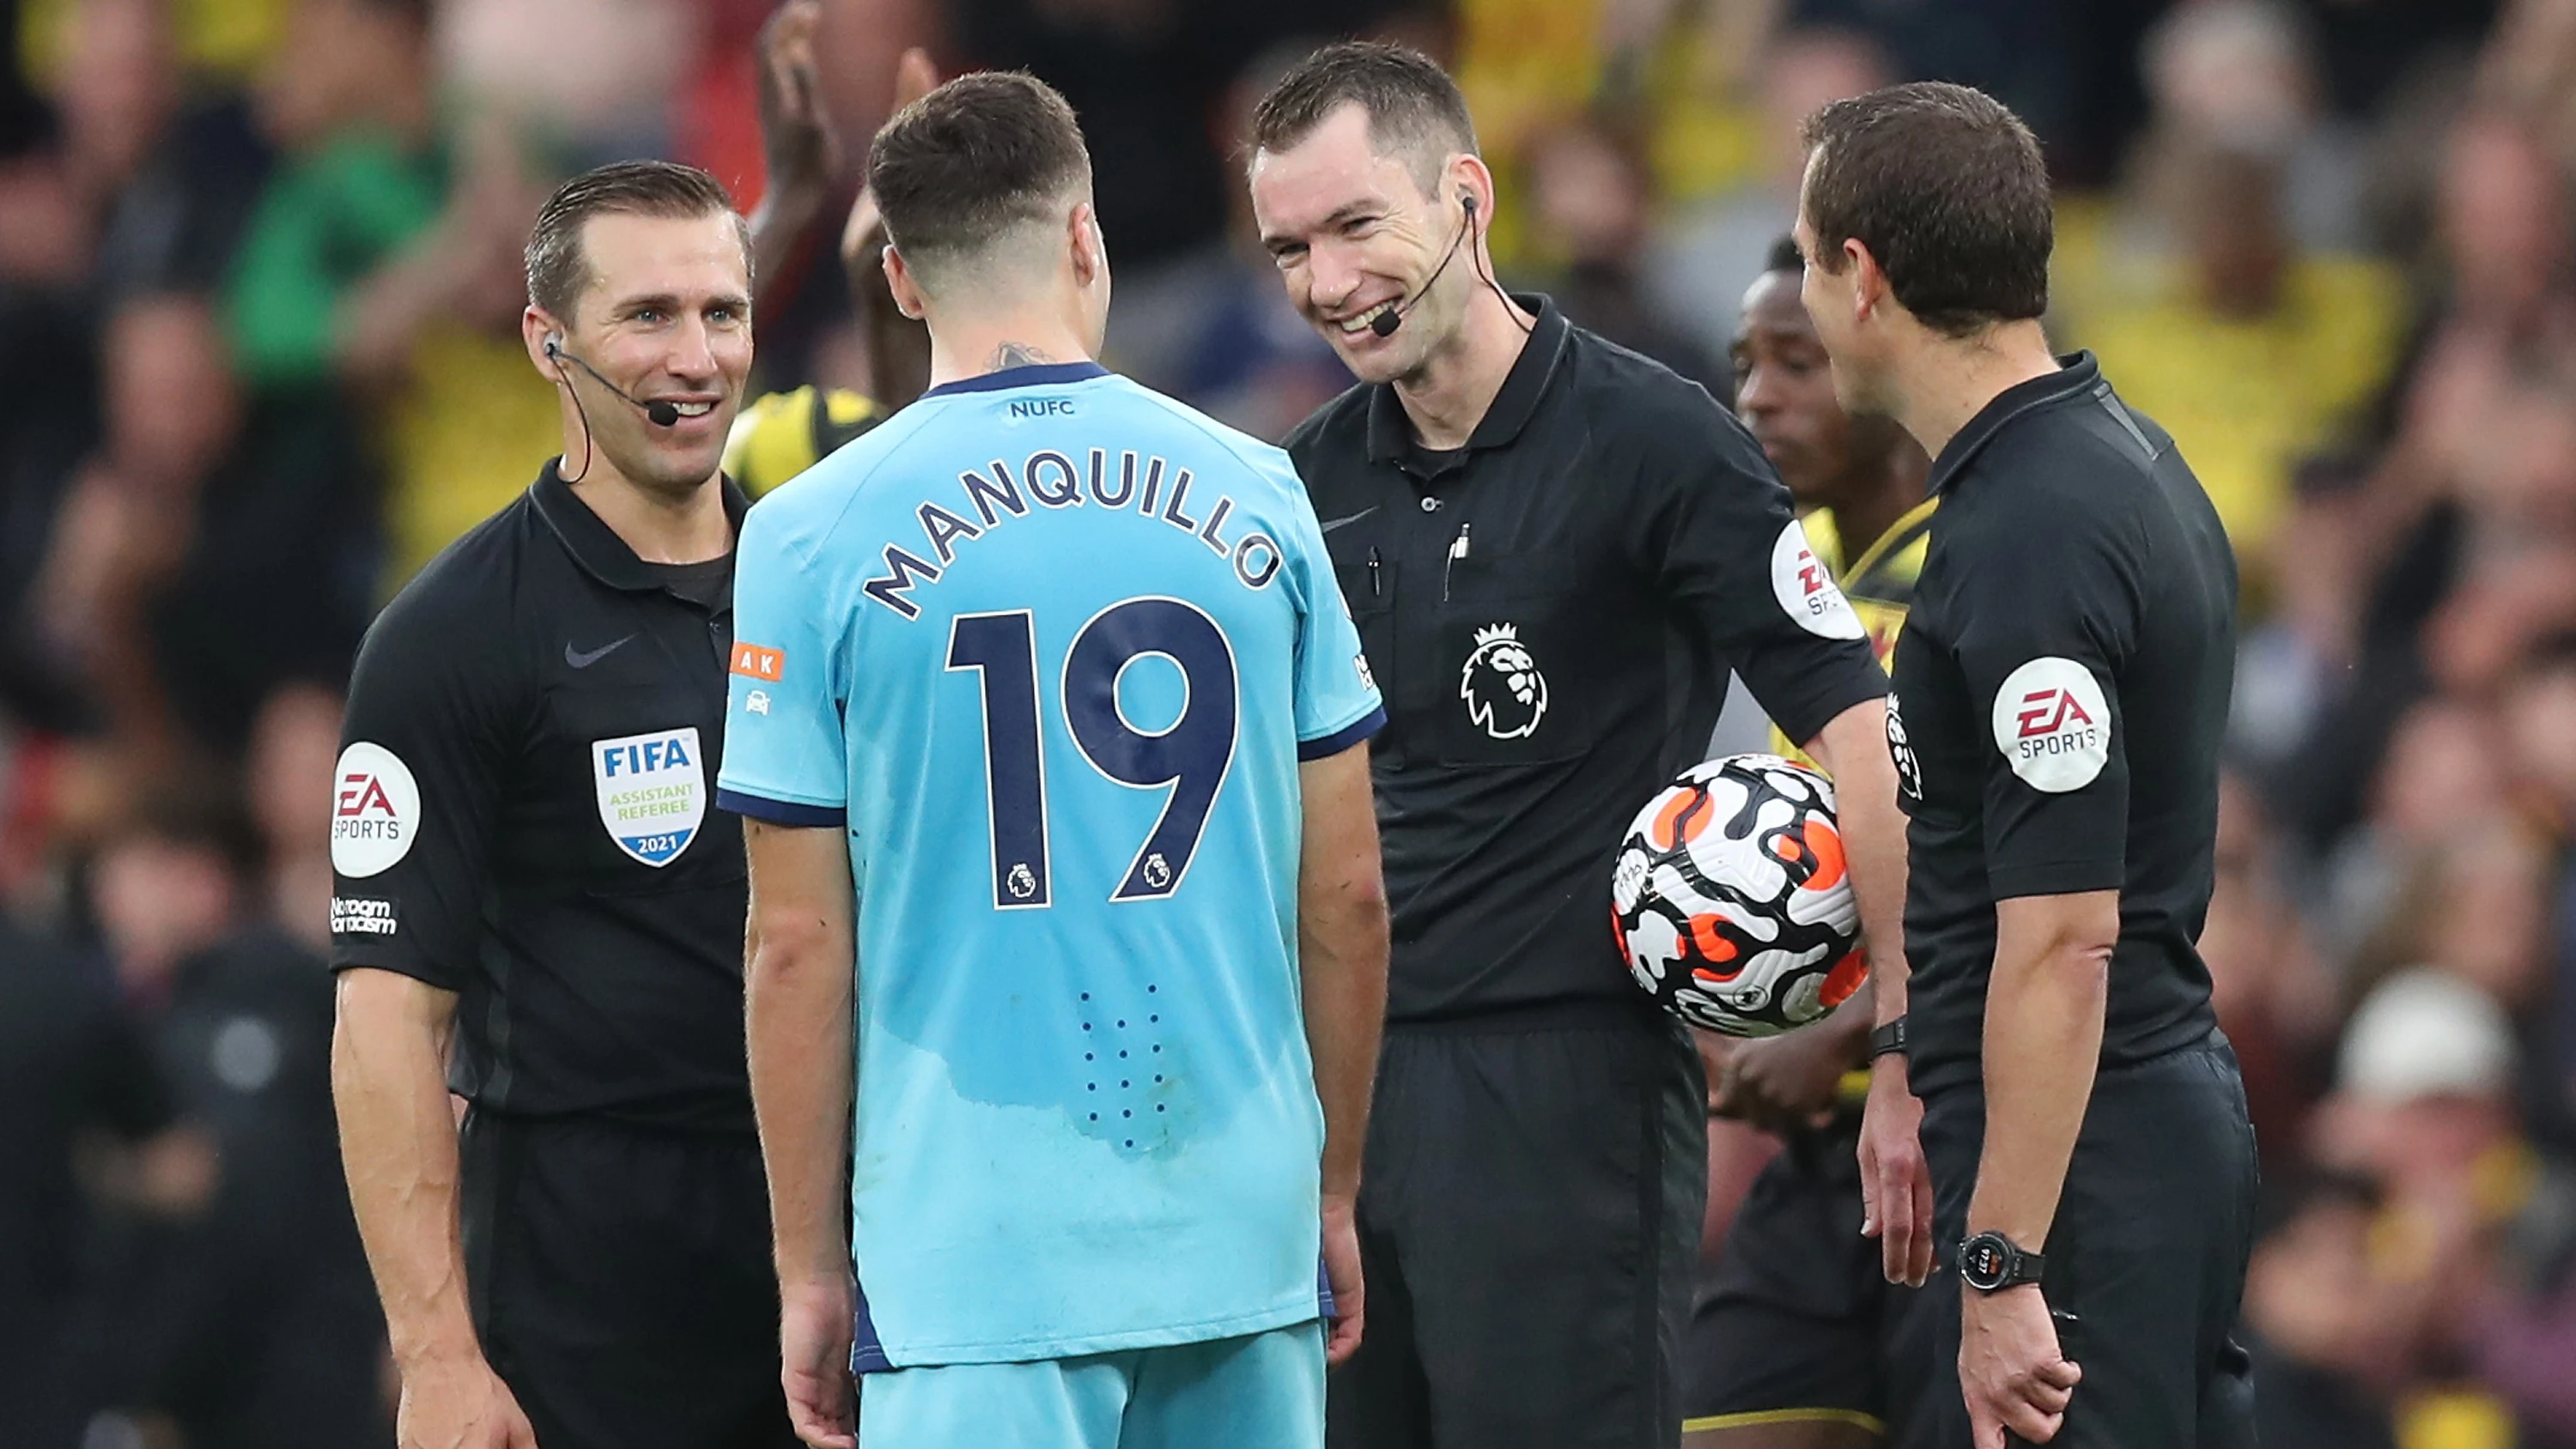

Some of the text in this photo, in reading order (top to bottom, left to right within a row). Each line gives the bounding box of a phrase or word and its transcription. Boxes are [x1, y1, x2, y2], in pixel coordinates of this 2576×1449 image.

[1011, 400, 1075, 418] NUFC
[863, 446, 1284, 621] MANQUILLO
[2016, 688, 2093, 738] EA
[604, 738, 690, 778] FIFA
[945, 594, 1241, 911] 19
[2019, 728, 2096, 760] SPORTS
[337, 773, 397, 816] EA
[610, 782, 694, 806] ASSISTANT
[617, 798, 690, 821] REFEREE
[334, 819, 399, 840] SPORTS
[637, 834, 677, 854] 2021
[345, 899, 391, 918] room
